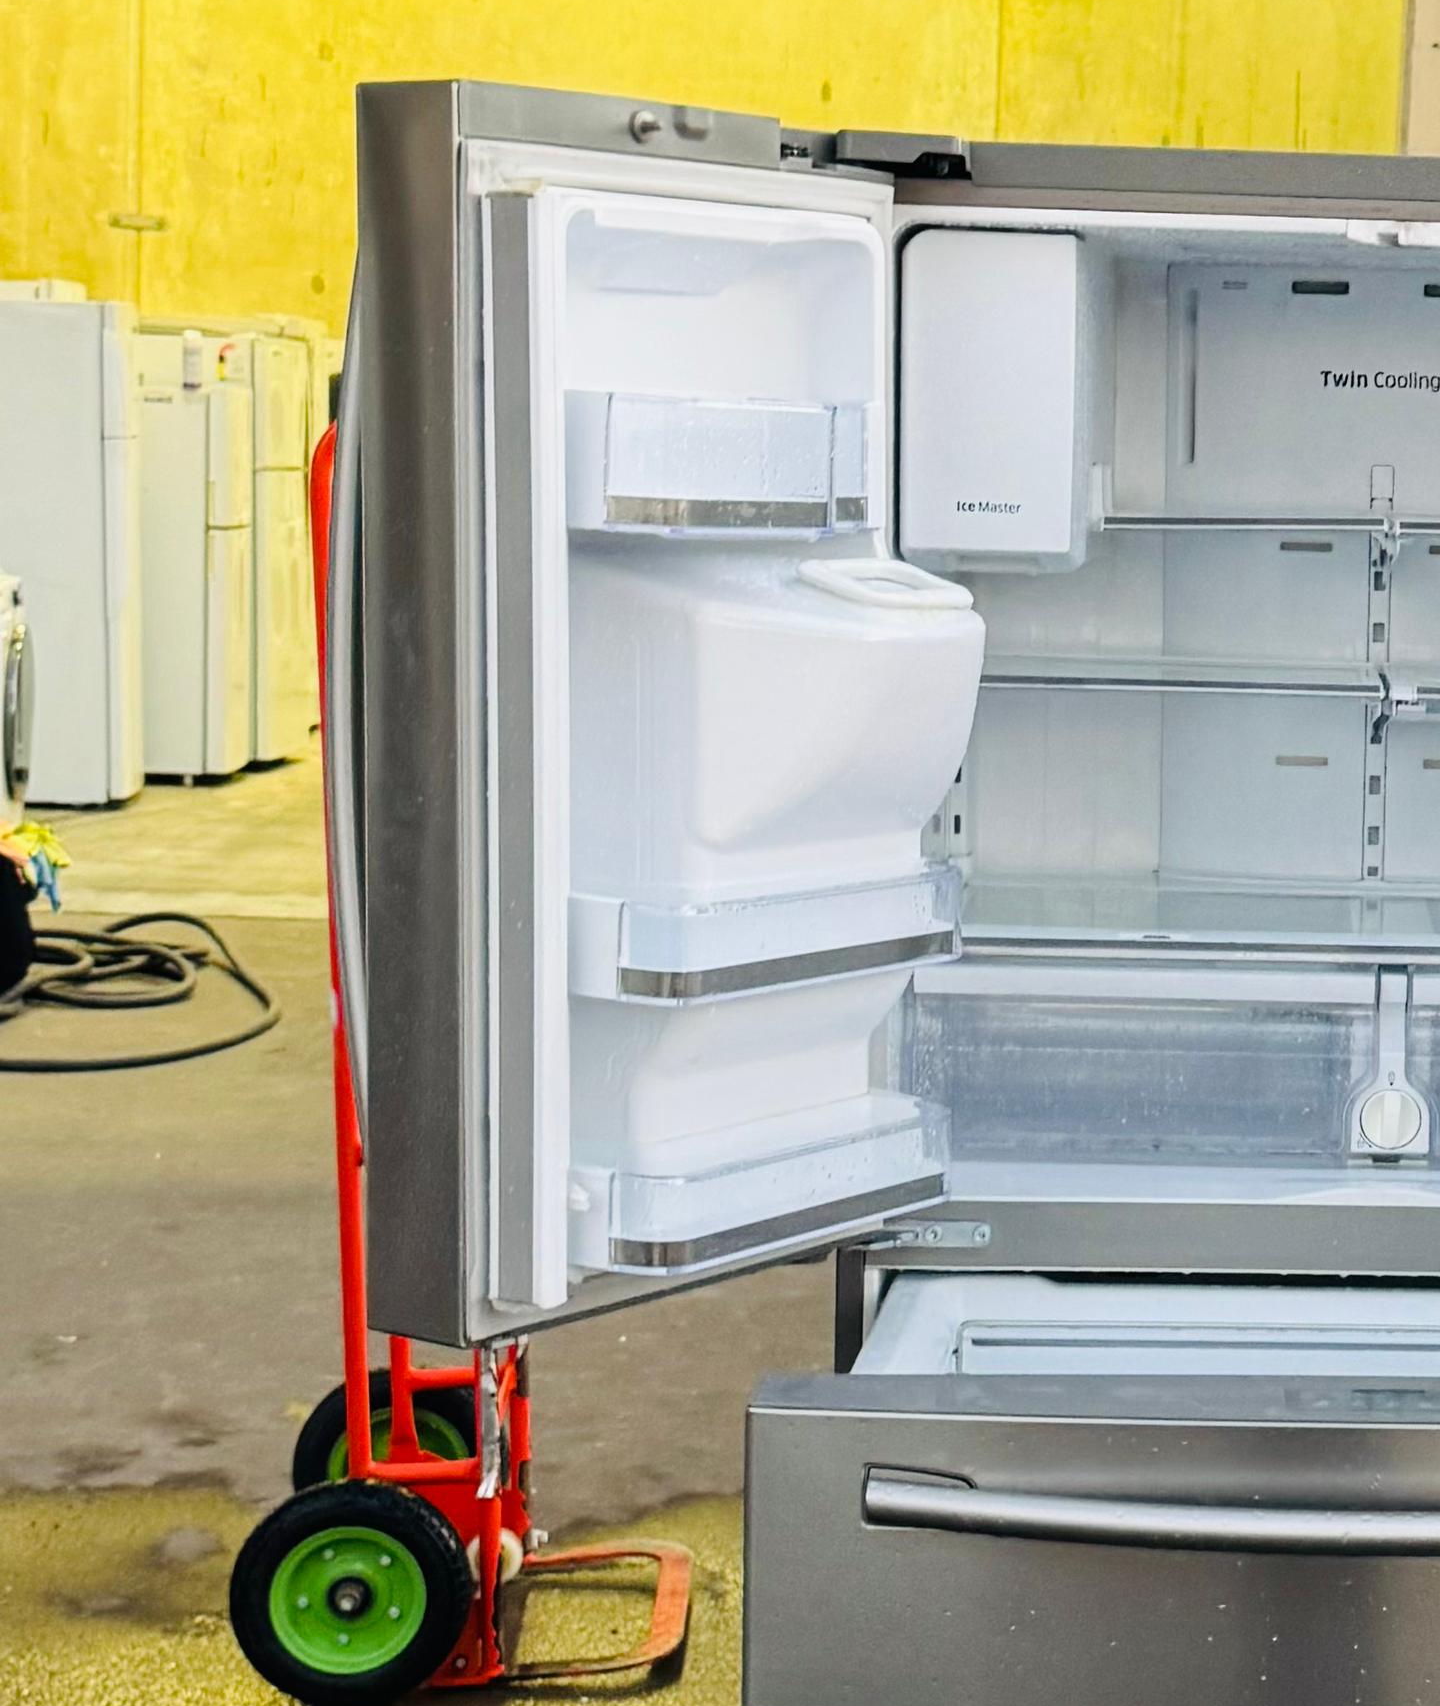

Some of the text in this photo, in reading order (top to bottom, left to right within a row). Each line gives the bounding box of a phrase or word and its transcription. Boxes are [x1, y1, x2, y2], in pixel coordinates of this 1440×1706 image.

[1320, 370, 1368, 388] Twin
[1373, 370, 1440, 393] Cooling
[956, 500, 1022, 515] Ice Master
